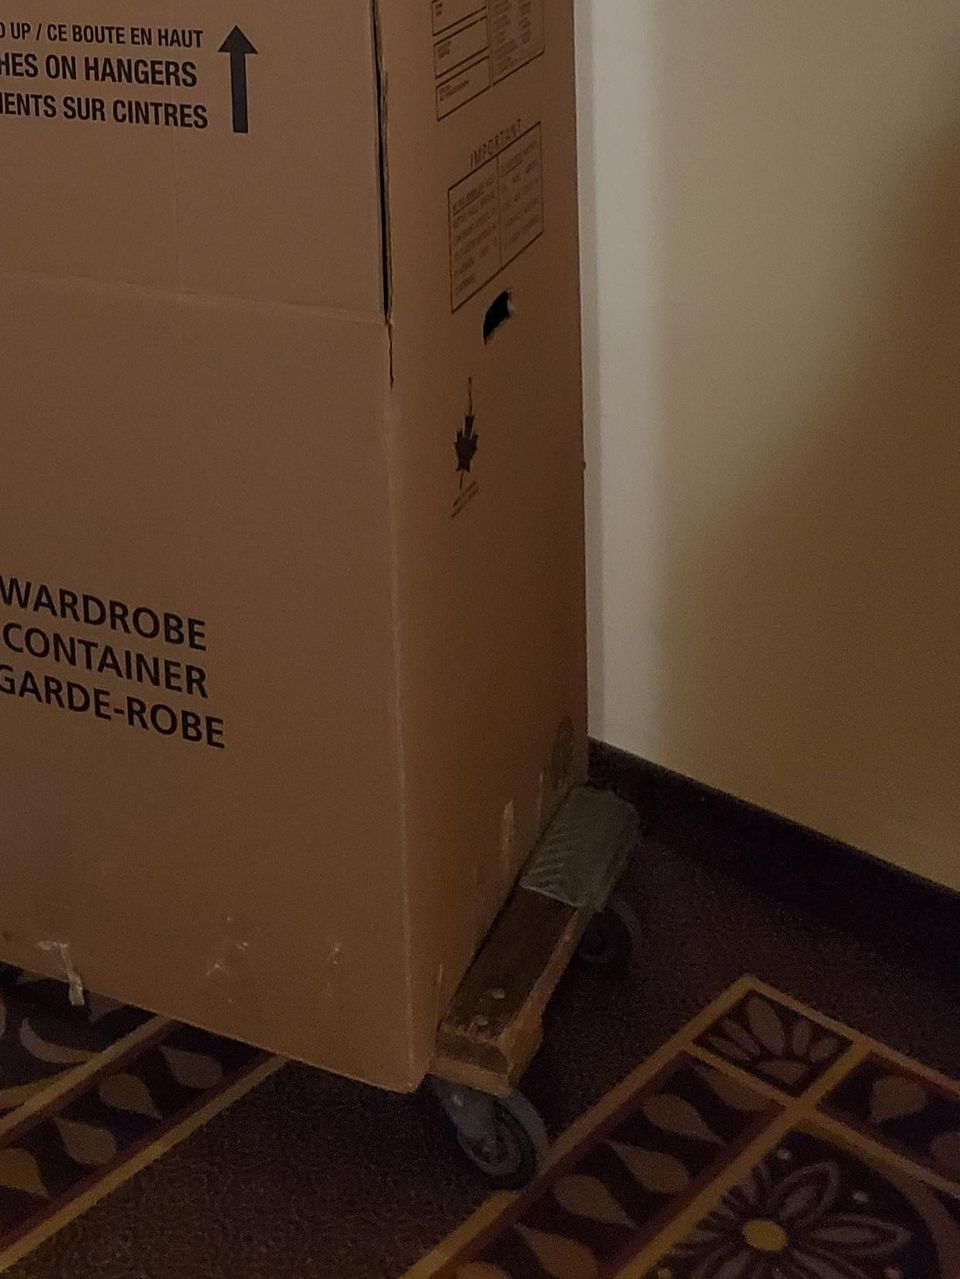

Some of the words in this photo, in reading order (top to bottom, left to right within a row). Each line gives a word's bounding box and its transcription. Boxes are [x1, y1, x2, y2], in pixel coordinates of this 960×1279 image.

[10, 21, 32, 41] UP
[46, 23, 68, 42] CE
[71, 24, 126, 45] BOUTE
[130, 26, 153, 46] EN
[157, 28, 204, 49] HAUT
[45, 54, 77, 81] ON
[84, 56, 198, 88] HANGERS
[62, 96, 106, 122] SUR
[112, 99, 208, 129] CINTRES
[2, 622, 209, 699] CONTAINER
